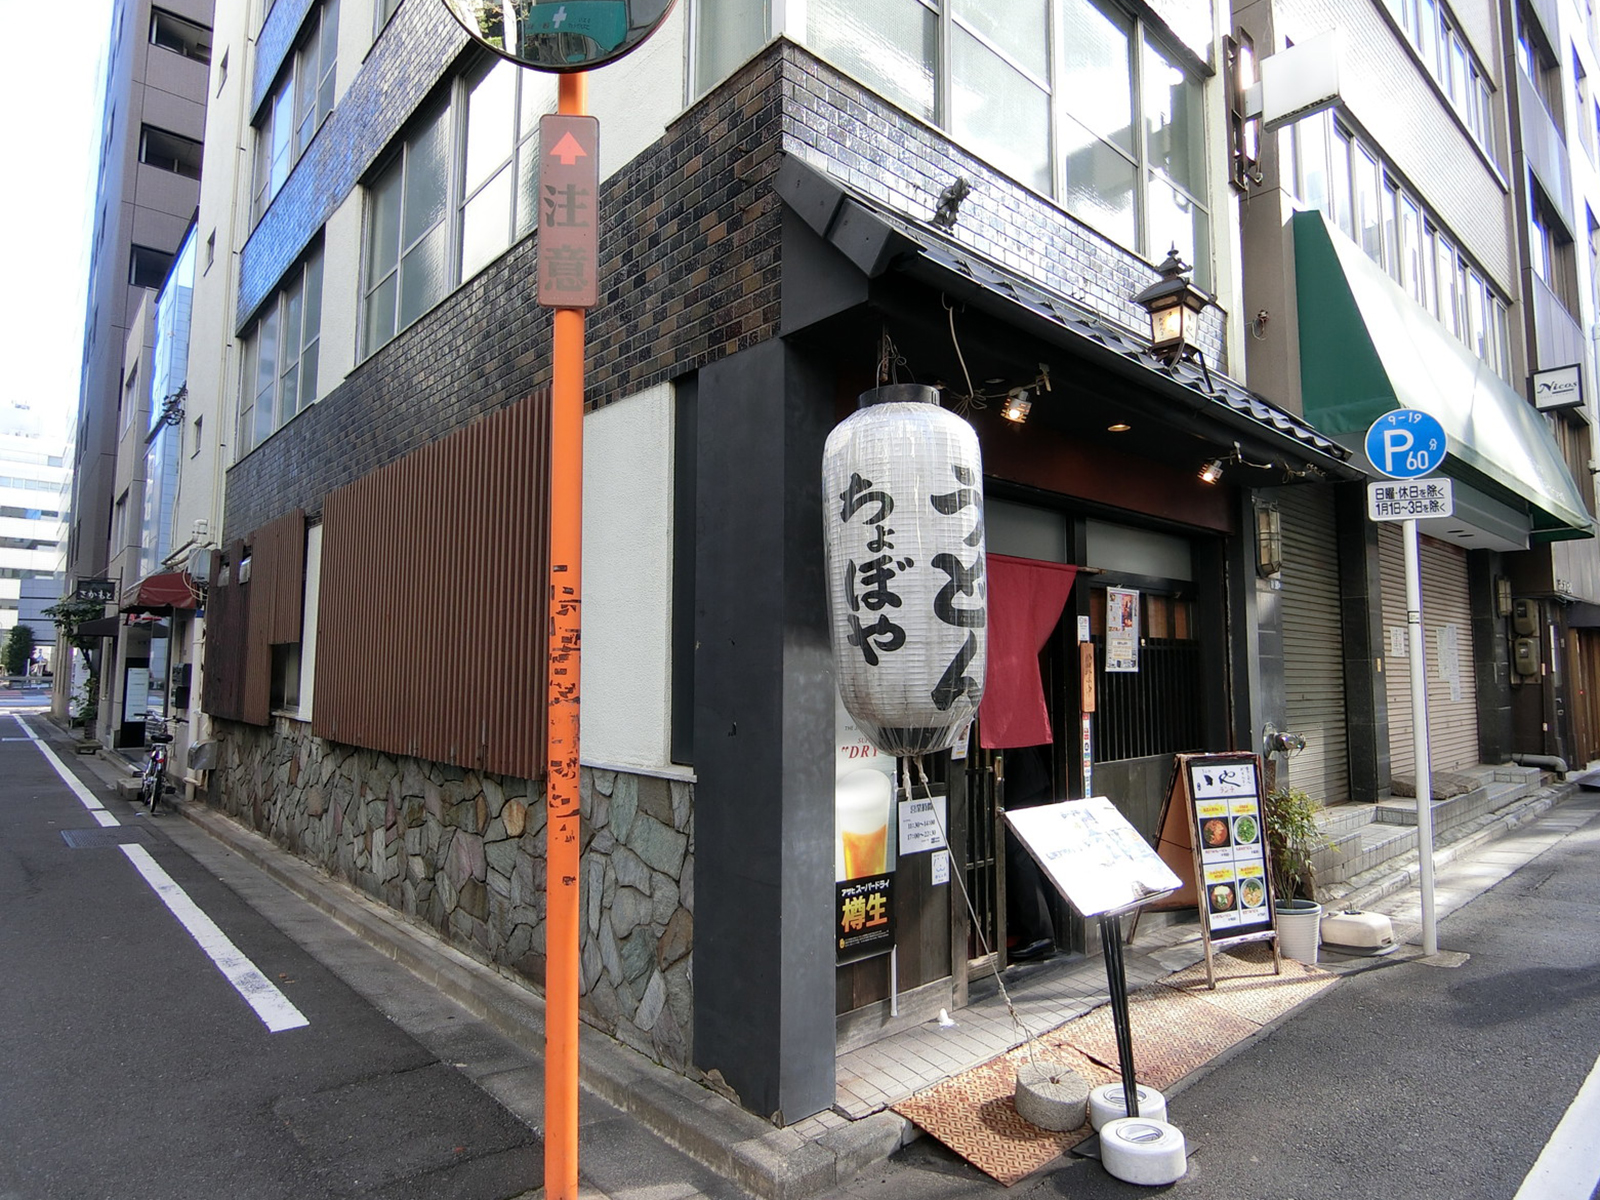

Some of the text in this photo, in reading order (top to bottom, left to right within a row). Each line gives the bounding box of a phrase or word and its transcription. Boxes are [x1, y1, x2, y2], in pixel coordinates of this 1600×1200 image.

[543, 183, 591, 293] 注意
[1387, 411, 1422, 426] 9-19
[1384, 428, 1414, 472] P
[1375, 484, 1445, 500] 日曜・休日を除く
[839, 472, 915, 667] ちょぼや
[930, 463, 986, 711] うどん
[841, 879, 890, 897] アサヒスーパードライ
[841, 892, 888, 933] 樽生
